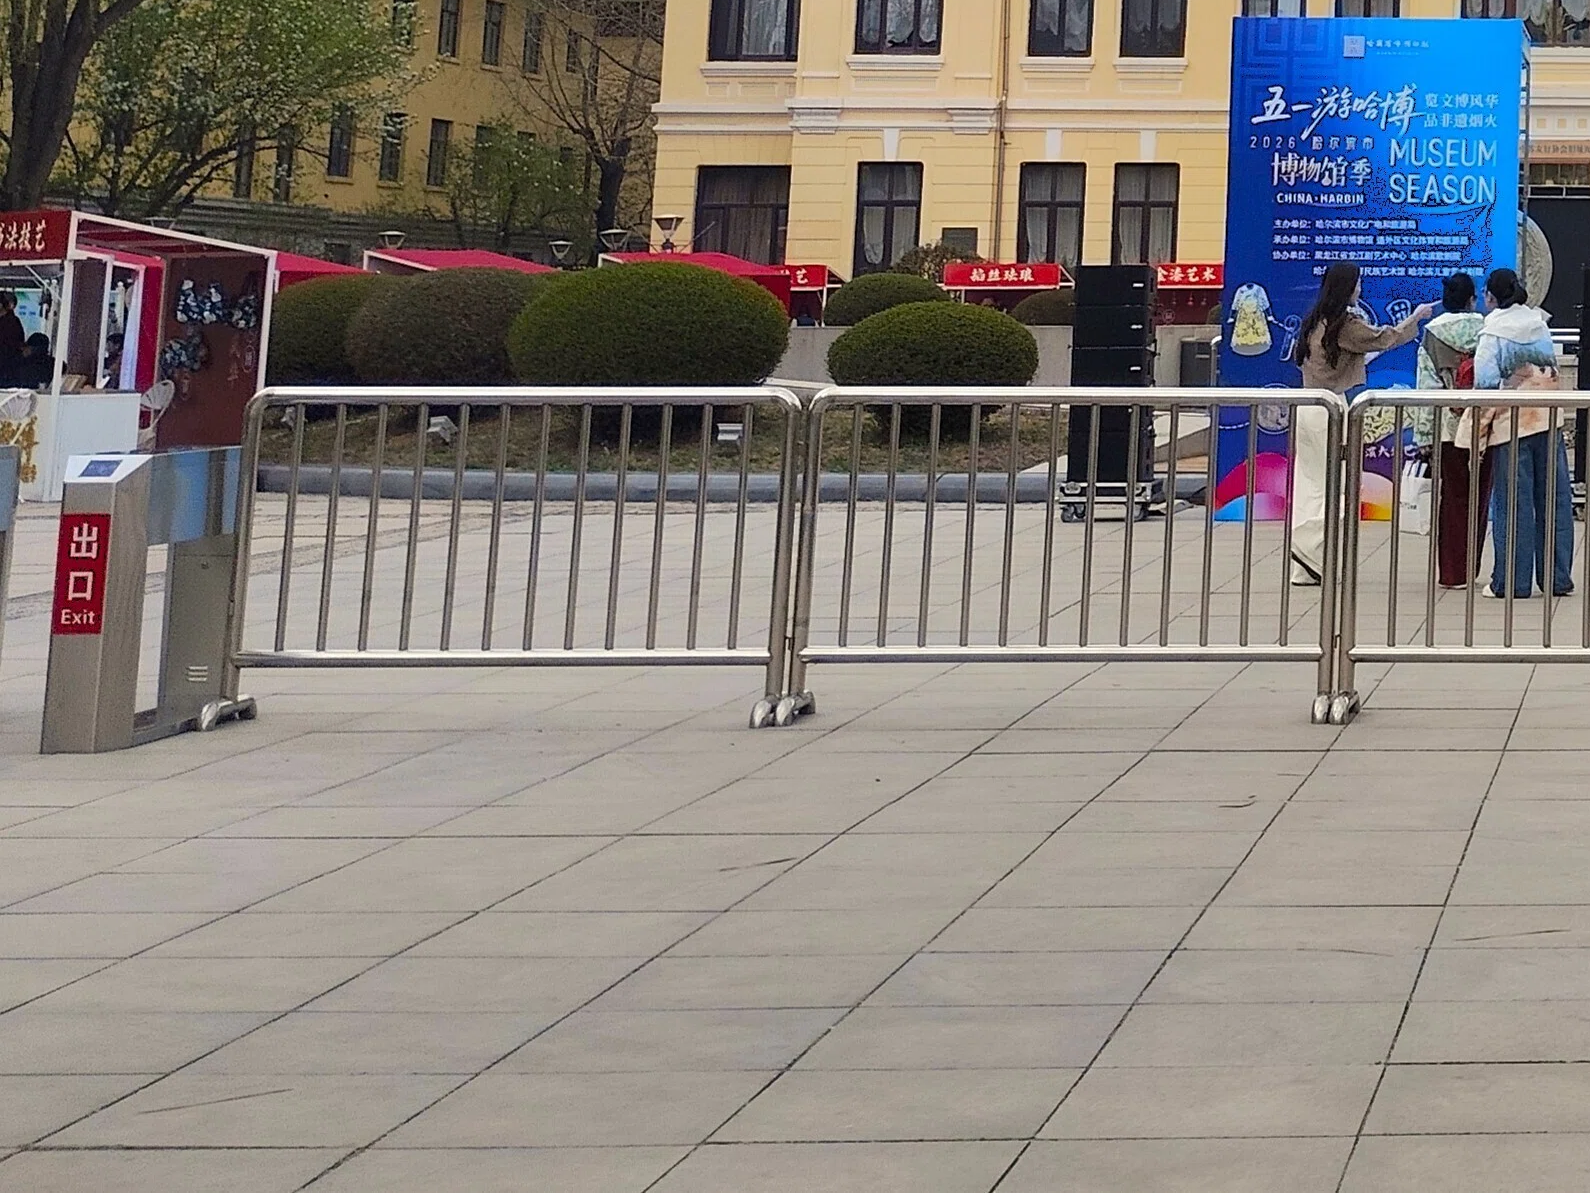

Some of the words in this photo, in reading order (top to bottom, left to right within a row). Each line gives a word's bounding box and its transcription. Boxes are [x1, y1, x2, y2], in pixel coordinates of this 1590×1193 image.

[1425, 93, 1499, 108] 览文博风华
[1423, 113, 1498, 128] 品非遗烟火
[1250, 136, 1296, 149] 2026
[1389, 138, 1498, 167] MUSEUM
[1271, 152, 1372, 187] 博物馆季
[1389, 174, 1496, 204] SEASON
[69, 522, 98, 601] 出口
[60, 608, 96, 625] Exit
